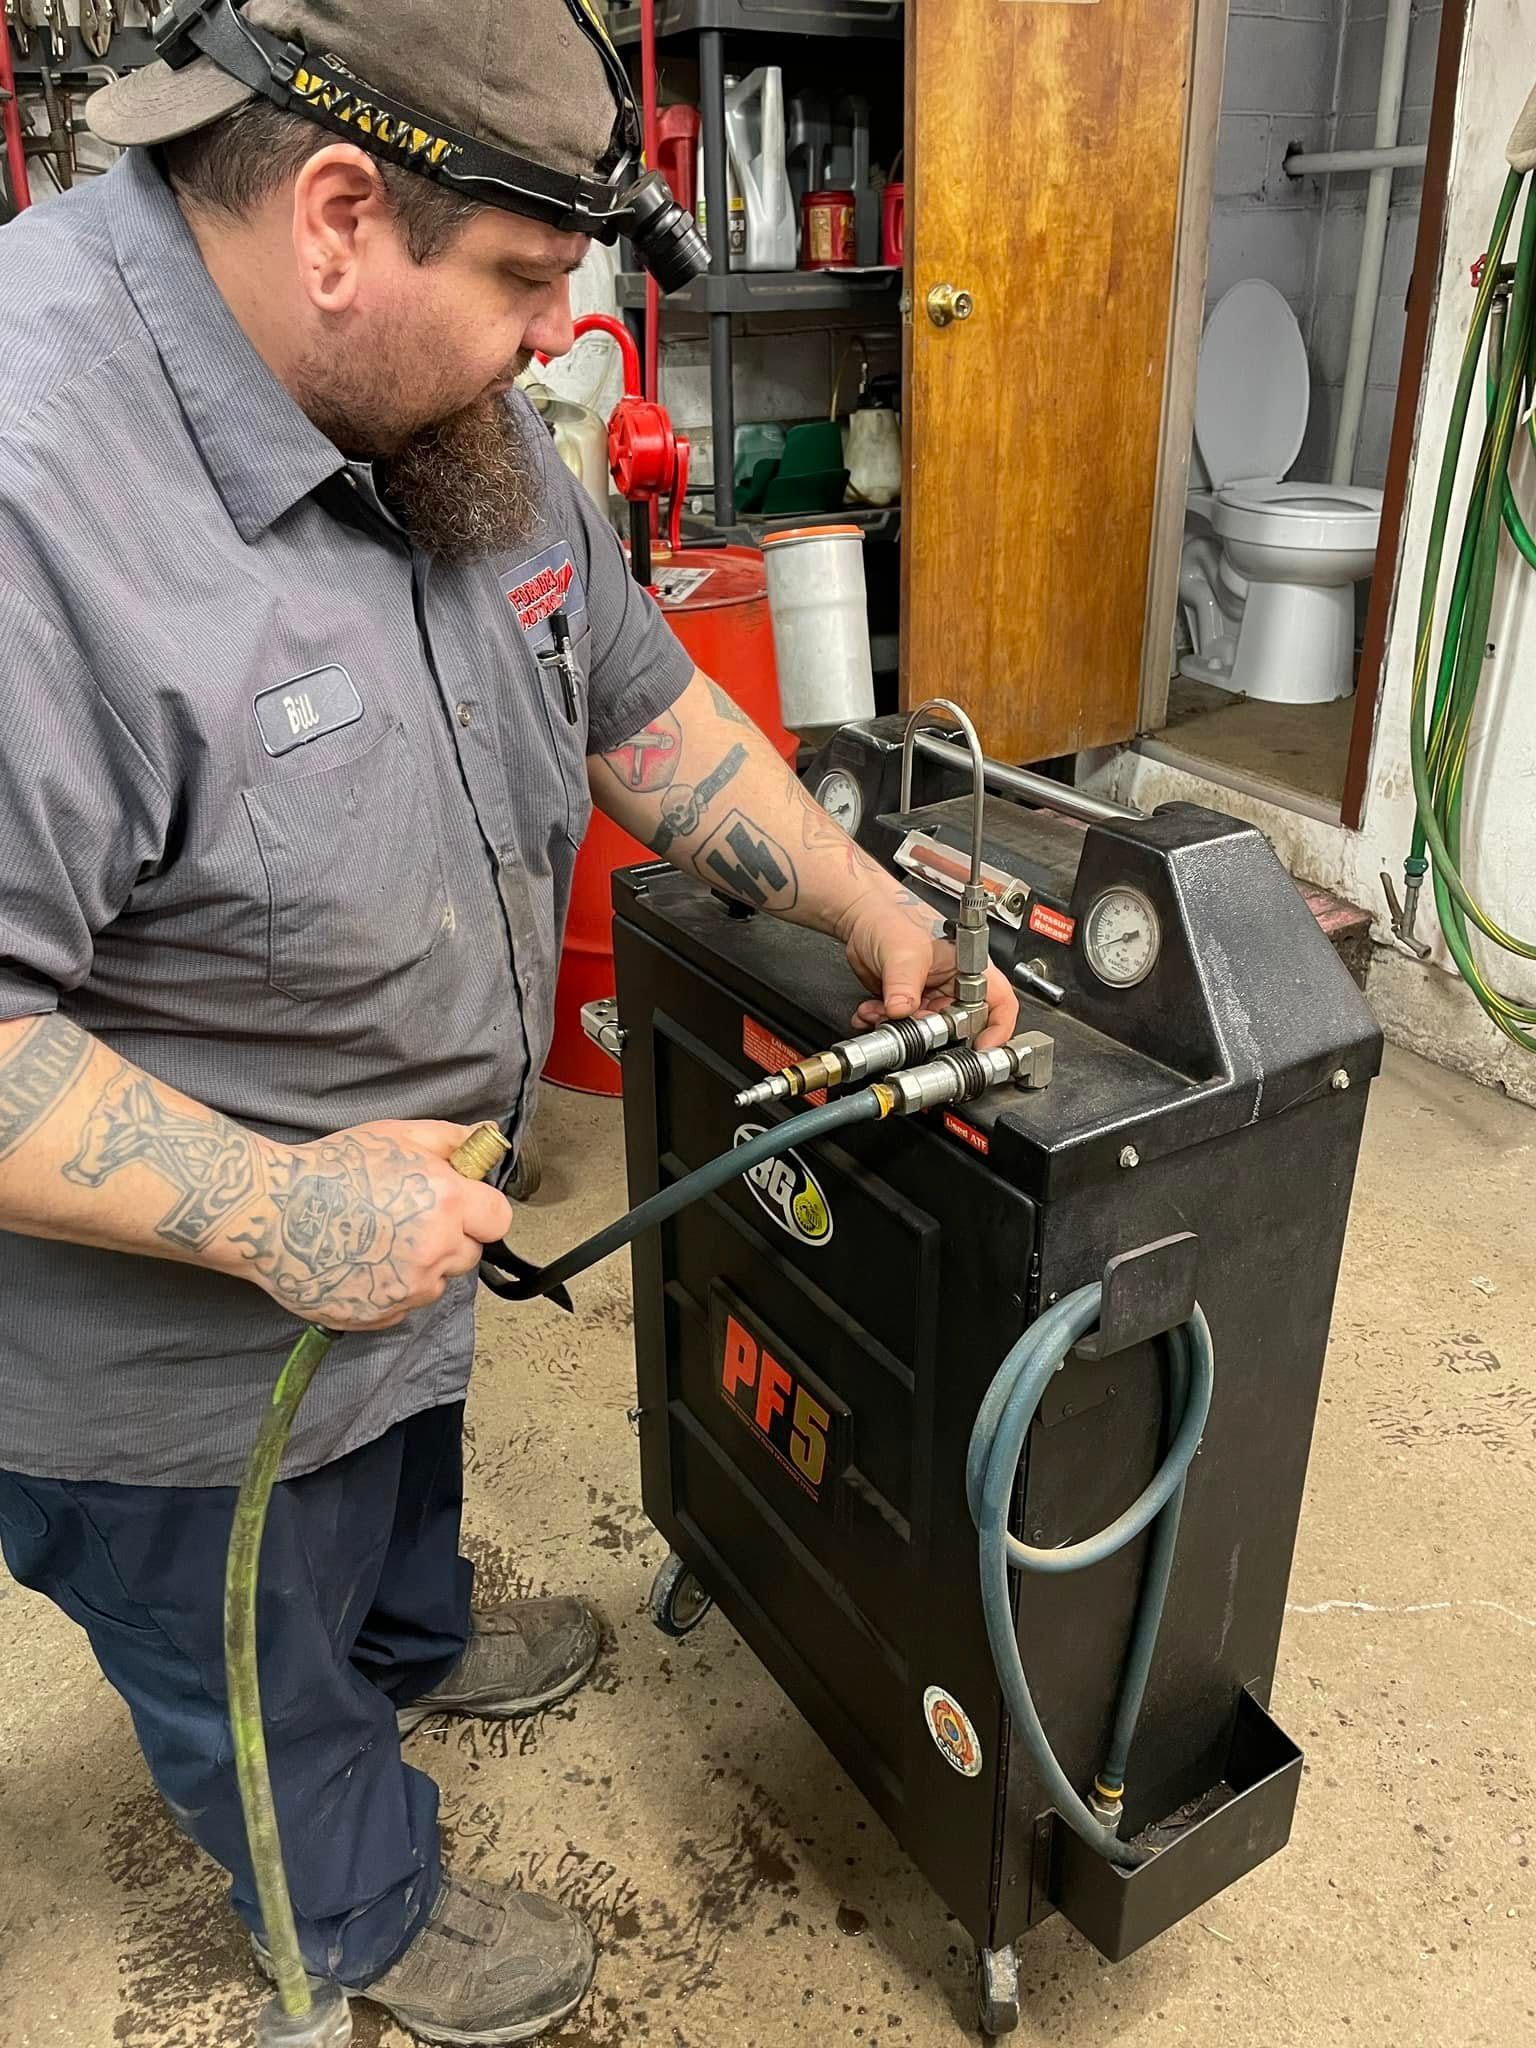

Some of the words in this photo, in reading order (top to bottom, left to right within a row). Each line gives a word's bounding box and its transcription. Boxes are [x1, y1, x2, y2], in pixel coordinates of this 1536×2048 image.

[283, 693, 320, 735] Bill
[1034, 908, 1073, 932] Pressure
[1034, 919, 1069, 941] Release
[946, 1117, 968, 1139] Used
[748, 1156, 797, 1205] BG
[722, 1315, 830, 1486] PF5
